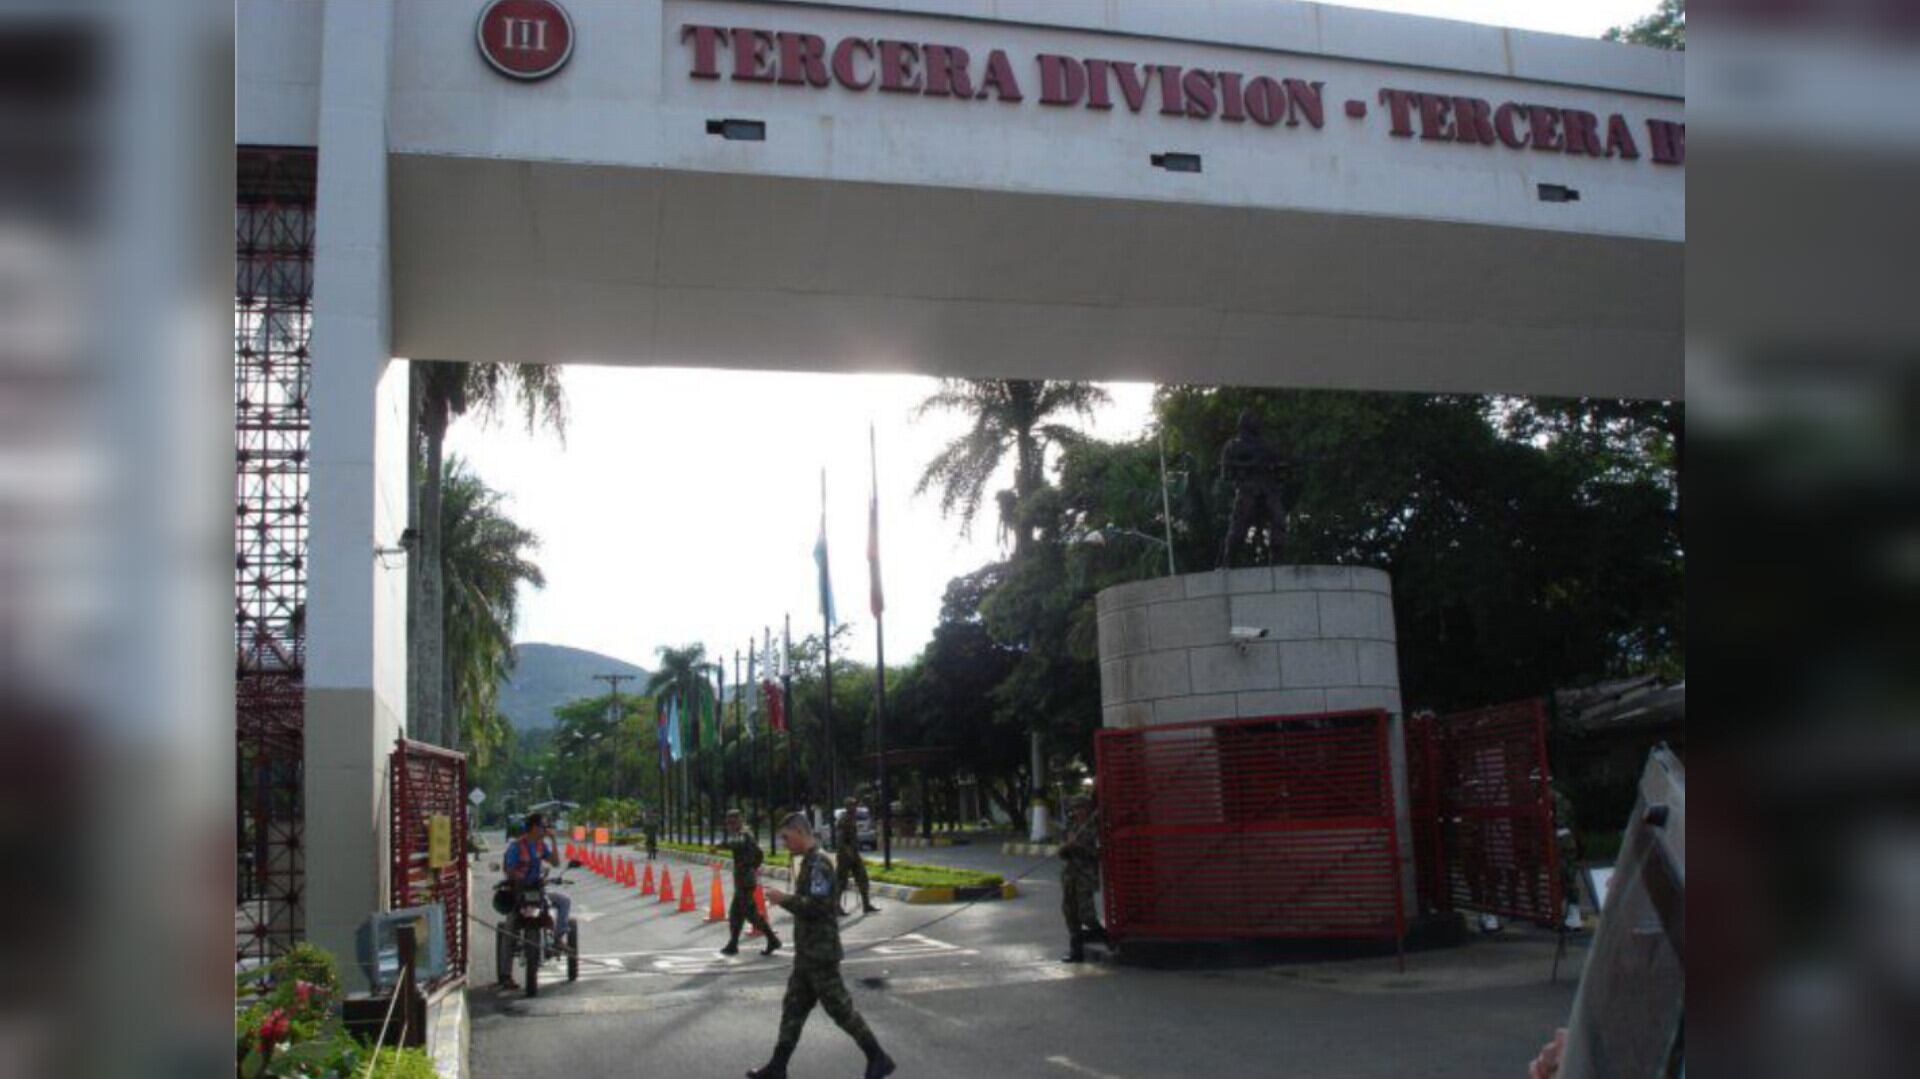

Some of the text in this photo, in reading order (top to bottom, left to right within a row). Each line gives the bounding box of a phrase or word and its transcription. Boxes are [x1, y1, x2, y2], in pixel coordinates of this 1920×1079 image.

[503, 17, 548, 51] III
[681, 24, 1022, 101] TERCERA
[1037, 54, 1325, 128] DIVISION
[1379, 88, 1640, 160] TERCERA
